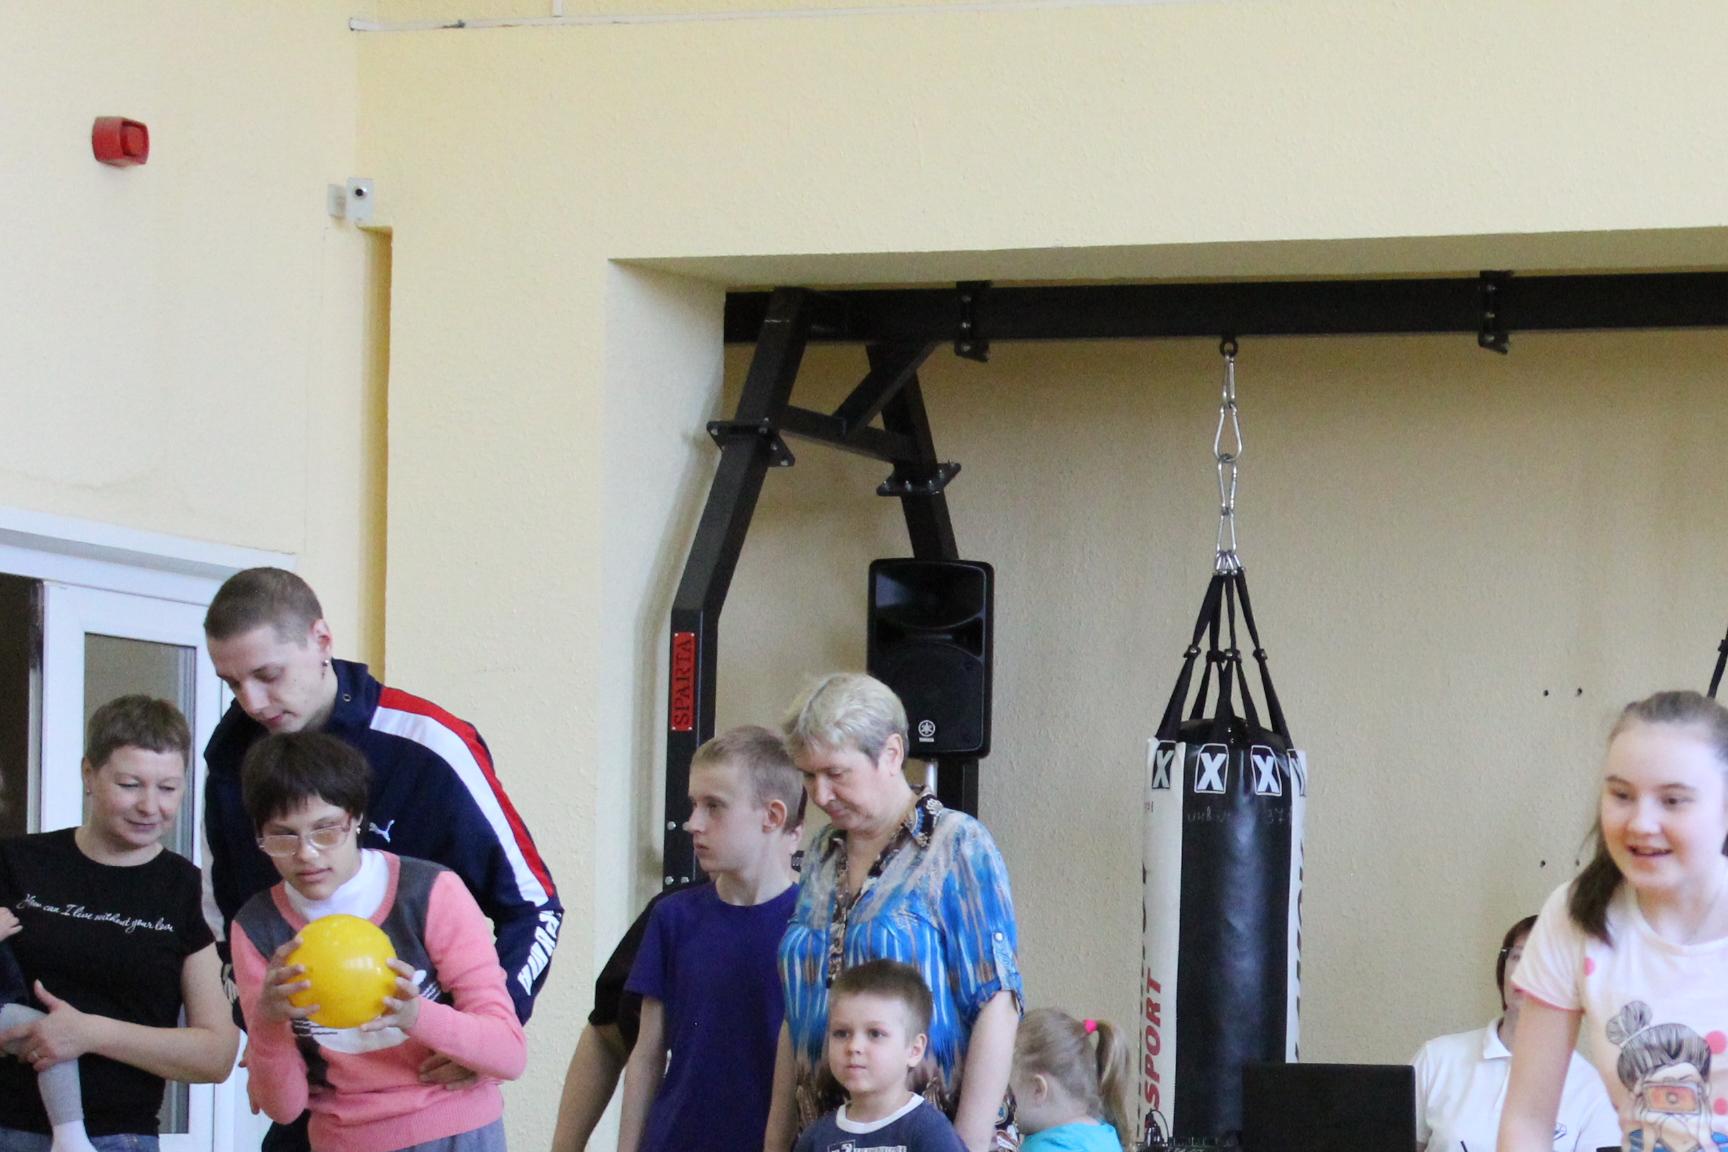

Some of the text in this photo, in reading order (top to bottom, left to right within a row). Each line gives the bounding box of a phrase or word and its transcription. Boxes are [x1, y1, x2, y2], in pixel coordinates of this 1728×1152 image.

[674, 640, 692, 725] SPARTA
[43, 904, 61, 913] can
[94, 912, 132, 927] without
[1144, 967, 1162, 1110] SPORT
